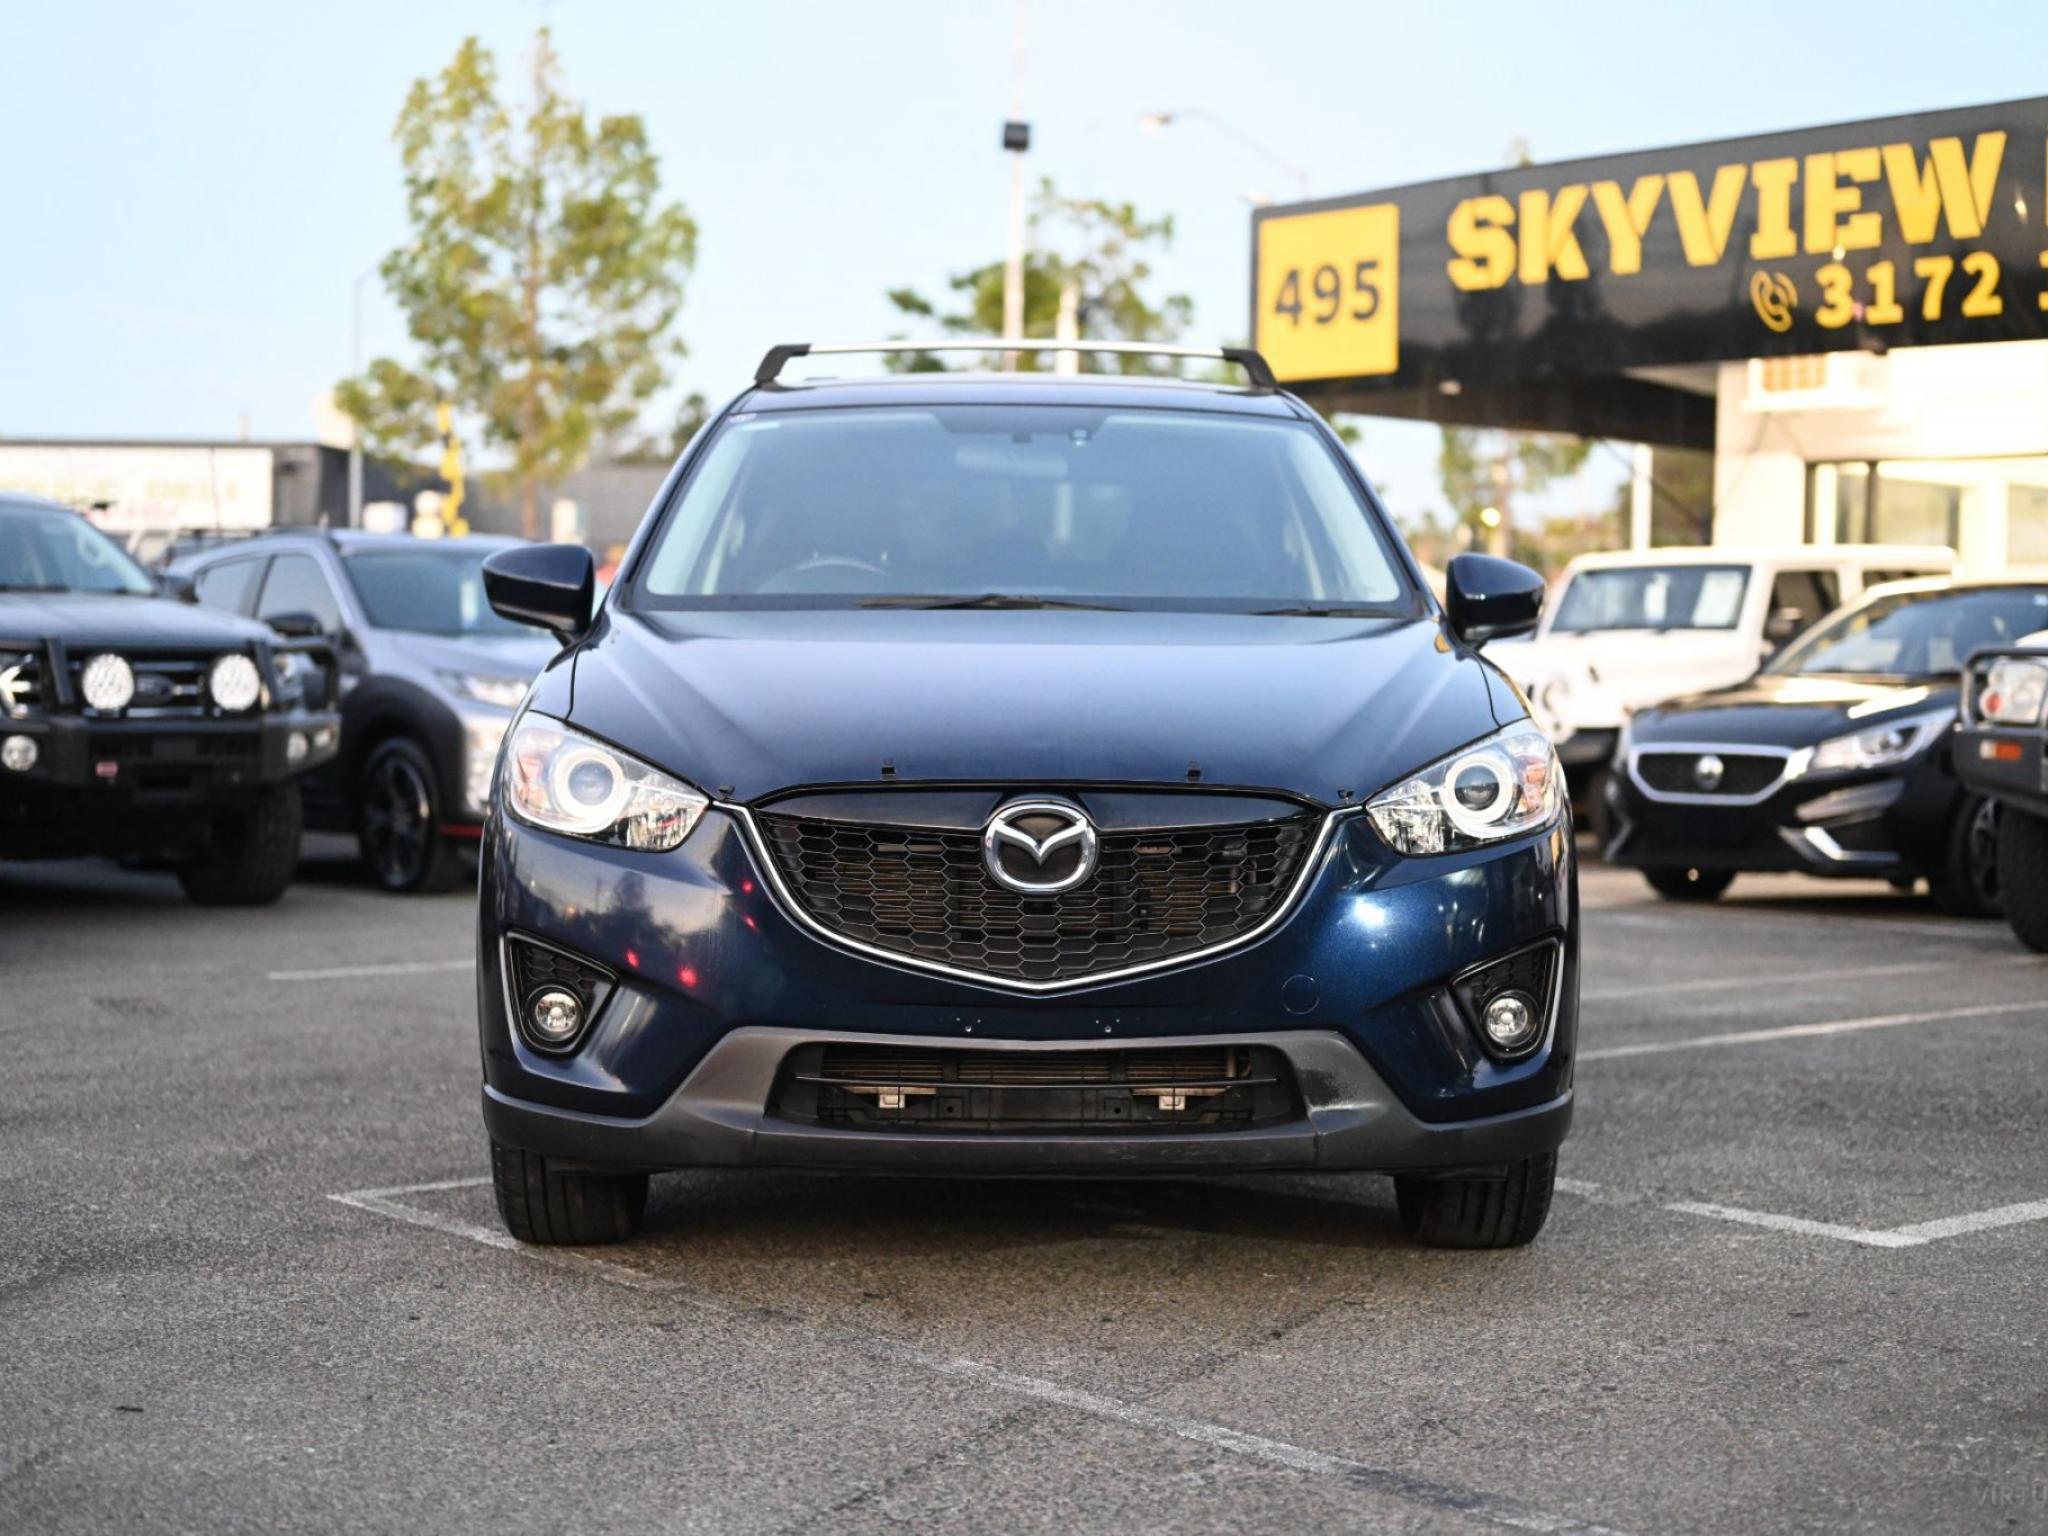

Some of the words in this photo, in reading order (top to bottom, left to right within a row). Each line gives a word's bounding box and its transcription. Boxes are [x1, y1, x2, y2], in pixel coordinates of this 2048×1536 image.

[1447, 131, 2007, 291] SKYVIEW
[1275, 260, 1379, 326] 495
[1814, 251, 2003, 329] 3172
